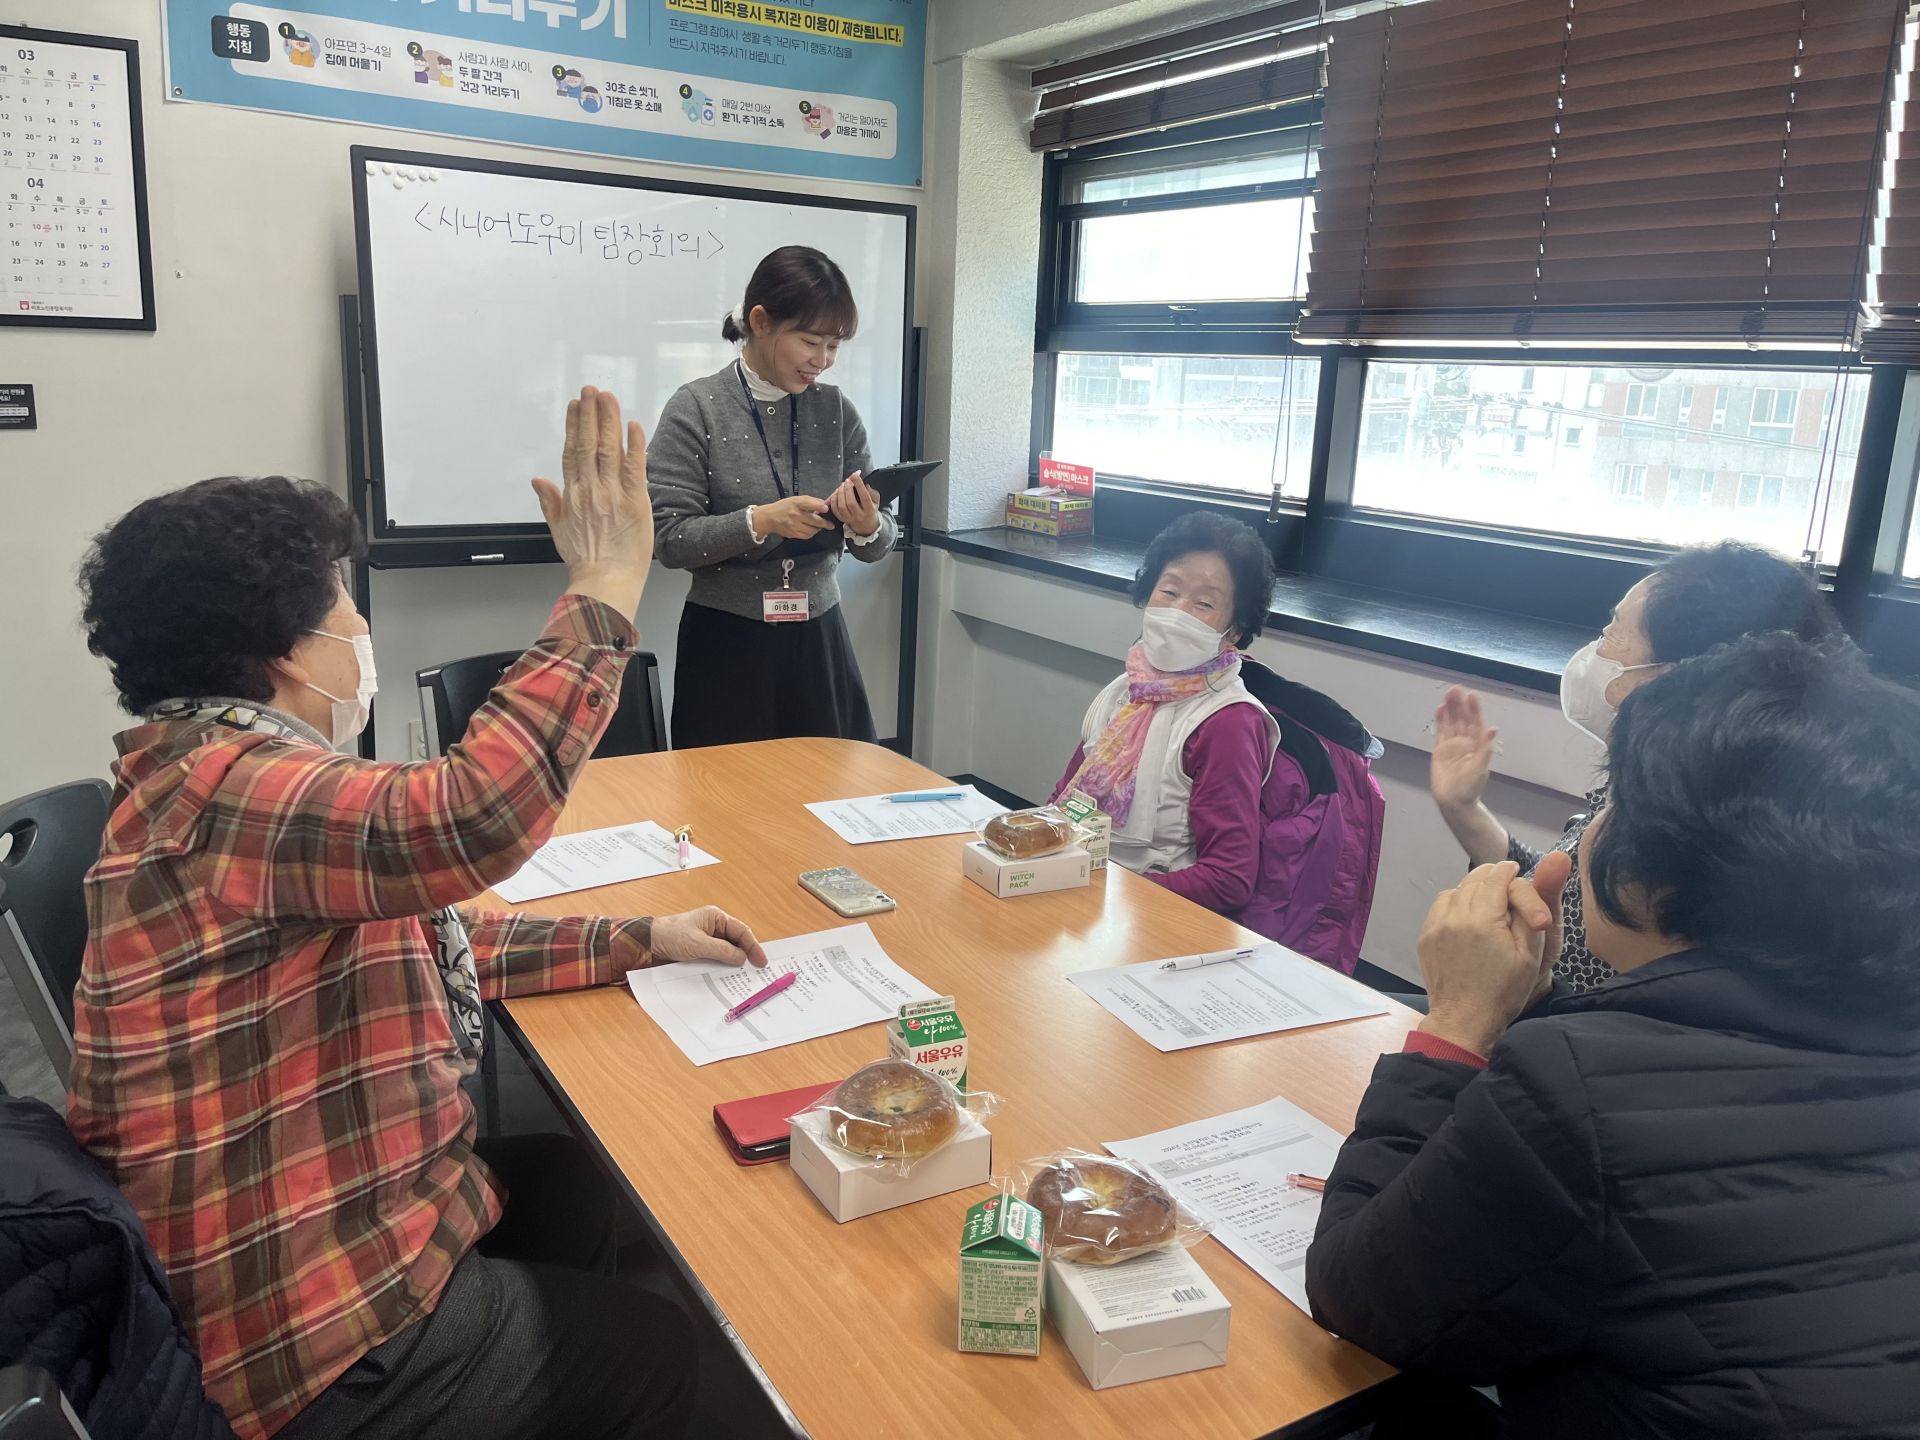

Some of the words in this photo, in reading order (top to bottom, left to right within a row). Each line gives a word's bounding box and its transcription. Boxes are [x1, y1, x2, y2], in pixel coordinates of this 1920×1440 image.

[711, 0, 761, 21] 미착용시
[765, 8, 801, 27] 복지관
[804, 15, 839, 34] 이용이
[842, 21, 901, 42] 제한됩니다.
[227, 23, 251, 37] 행동
[283, 26, 289, 35] 1
[669, 18, 707, 35] 프로그램
[709, 25, 738, 40] 참여시
[742, 31, 761, 44] 생활
[762, 35, 771, 46] 속
[774, 36, 809, 52] 거리두기
[811, 42, 853, 59] 행동지침을
[228, 39, 252, 54] 지침
[325, 38, 358, 53] 아프면
[360, 43, 392, 58] 3~4일
[412, 46, 419, 54] 2
[669, 37, 698, 52] 반드시
[701, 42, 747, 60] 지켜주시기
[18, 49, 35, 61] 03
[325, 54, 347, 67] 집에
[350, 57, 381, 71] 머물기
[459, 52, 487, 65] 사람과
[490, 56, 509, 69] 사람
[459, 67, 469, 77] 두
[470, 69, 481, 80] 팔
[483, 70, 503, 83] 간격
[556, 68, 562, 76] 3
[460, 81, 480, 93] 건강
[482, 84, 520, 100] 거리두기
[605, 82, 626, 94] 30초
[628, 85, 638, 95] 손
[682, 87, 689, 95] 4
[606, 96, 633, 109] 기침은
[634, 100, 643, 111] 옷
[645, 102, 662, 113] 소매
[721, 98, 738, 110] 매일
[740, 101, 754, 112] 2번
[754, 103, 771, 115] 이상
[802, 103, 808, 112] 5
[722, 112, 741, 125] 환기,
[742, 115, 767, 127] 주기적
[768, 118, 785, 129] 소독
[838, 112, 859, 125] 거리는
[859, 115, 889, 128] 멀어져도
[836, 126, 858, 137] 마음은
[858, 128, 881, 140] 가까이
[27, 177, 44, 189] 04
[1009, 872, 1035, 882] WITCH
[1009, 881, 1029, 889] PACK
[920, 1014, 954, 1027] 서울우유
[915, 1044, 964, 1065] 서울우유
